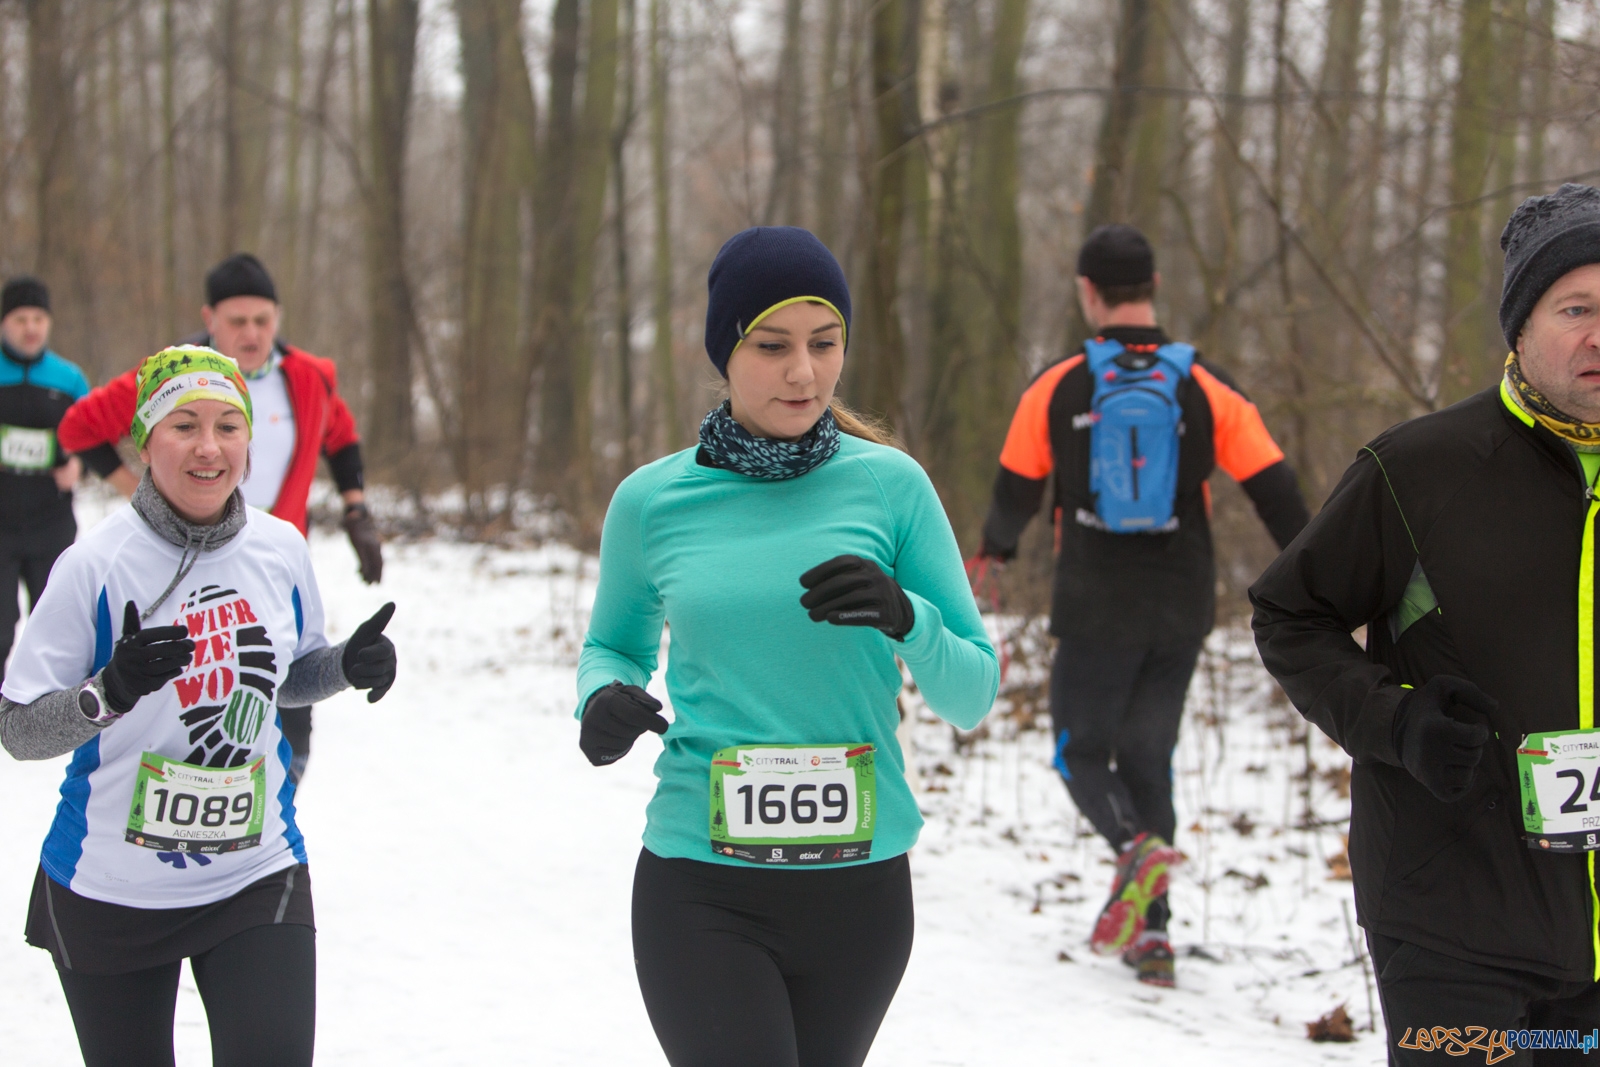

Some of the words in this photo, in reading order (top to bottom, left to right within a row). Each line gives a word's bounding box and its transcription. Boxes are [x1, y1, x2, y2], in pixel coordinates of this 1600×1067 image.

[184, 631, 235, 673] ZE
[173, 666, 234, 708] WO
[223, 689, 271, 745] RUN
[153, 788, 253, 827] 1089
[254, 794, 263, 825] Poznań
[737, 783, 849, 825] 1669
[861, 790, 871, 829] Poznań
[172, 829, 227, 839] AGNIESZKA
